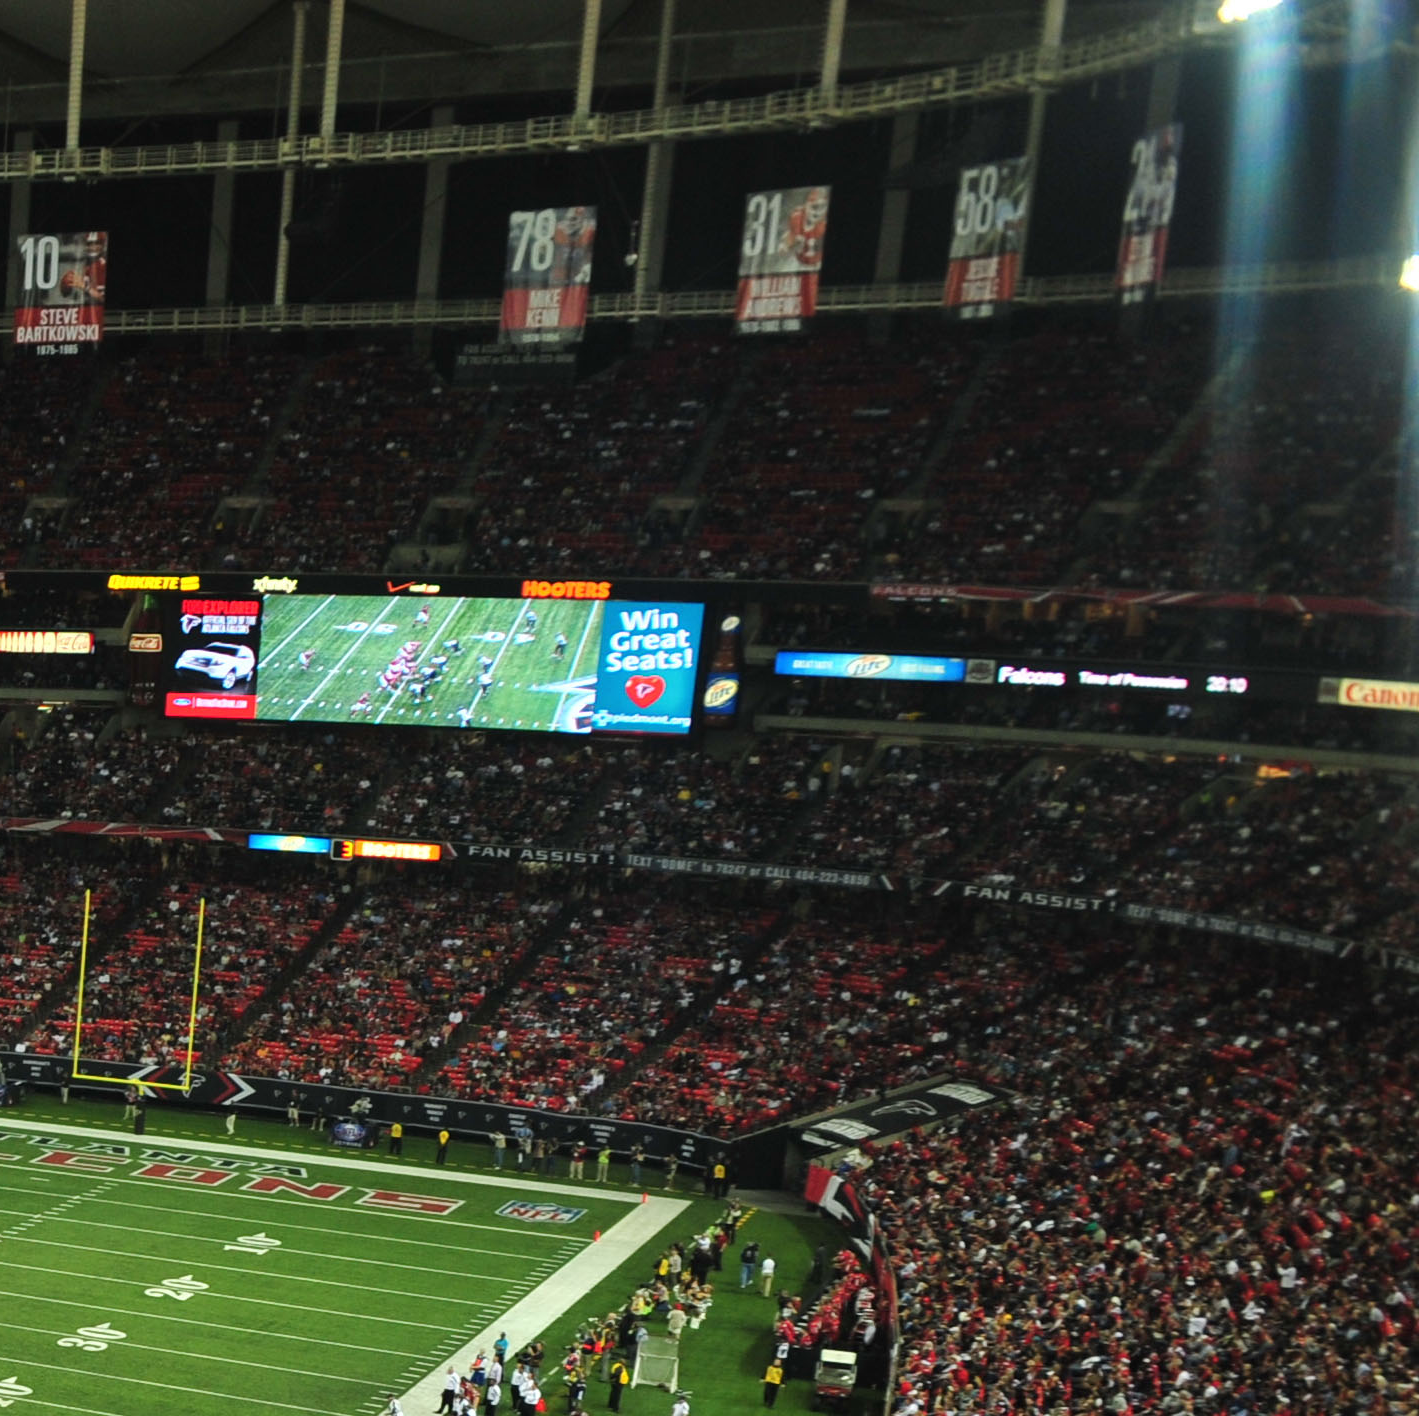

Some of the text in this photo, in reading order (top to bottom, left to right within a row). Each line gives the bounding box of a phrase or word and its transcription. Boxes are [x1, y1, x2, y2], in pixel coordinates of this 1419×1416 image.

[744, 195, 781, 256] 31
[509, 209, 556, 271] 78
[21, 236, 58, 289] 10
[529, 289, 560, 307] MIKE
[40, 308, 78, 324] STEVE
[17, 324, 98, 342] BARTKOWSKI
[106, 575, 177, 589] QUIKRETE
[522, 580, 612, 598] HOOTERS
[620, 609, 678, 631] Win
[610, 629, 690, 651] Great
[606, 648, 693, 672] Seats!
[997, 667, 1065, 686] Falcons
[1207, 676, 1246, 693] 20:10
[1346, 682, 1419, 707] Canon
[614, 713, 691, 727] piedmont.org
[339, 841, 350, 858] 3
[468, 845, 510, 858] FAN
[520, 849, 599, 863] ASSIST
[627, 855, 652, 867] TEXT
[765, 867, 791, 879] CALL
[964, 885, 1009, 900] FAN
[1019, 892, 1101, 910] ASSIST
[225, 1235, 282, 1255] 10
[144, 1278, 209, 1301] 20
[57, 1326, 127, 1351] 30
